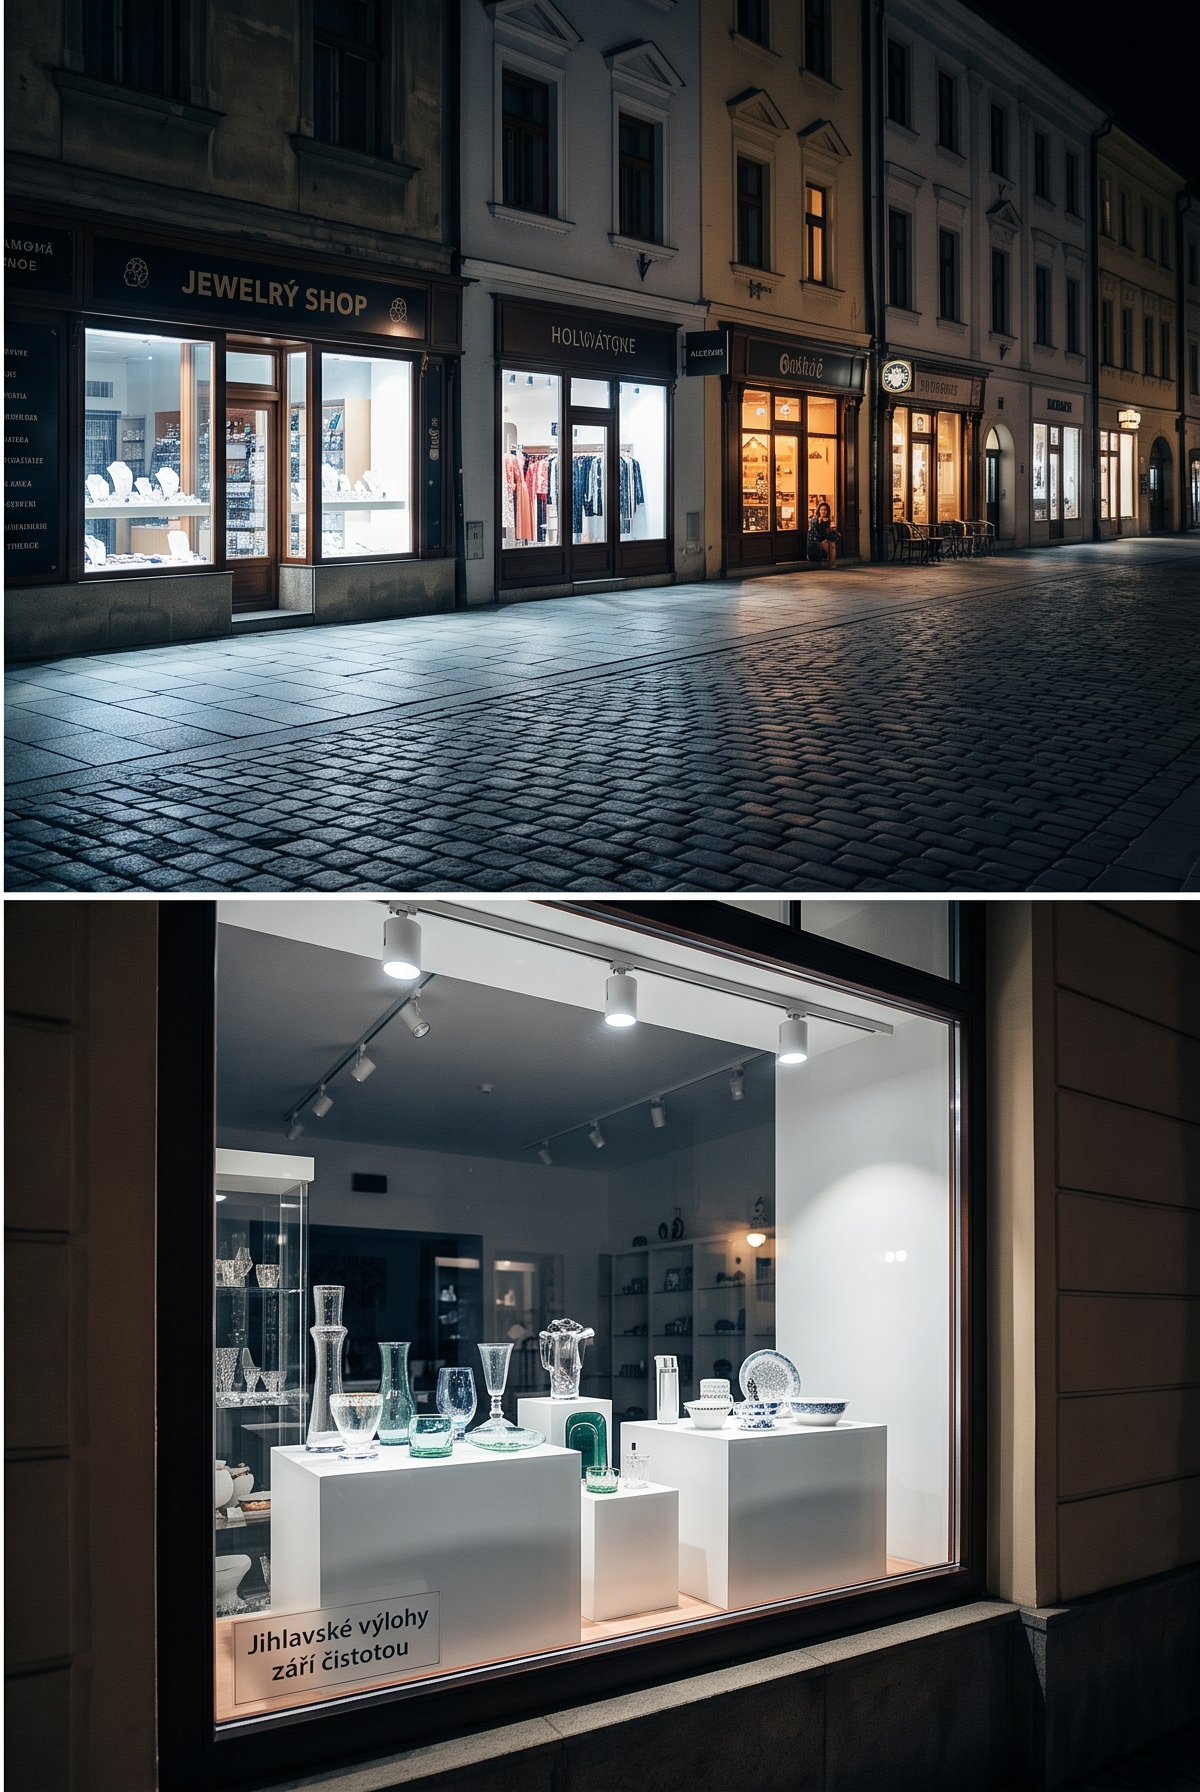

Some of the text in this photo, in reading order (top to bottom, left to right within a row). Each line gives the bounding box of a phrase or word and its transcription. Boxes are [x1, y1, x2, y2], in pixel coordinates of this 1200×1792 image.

[181, 269, 368, 317] JEWELRÝ SHOP
[247, 1607, 430, 1656] Jihlavské výlohy
[271, 1641, 410, 1682] září čistotou
